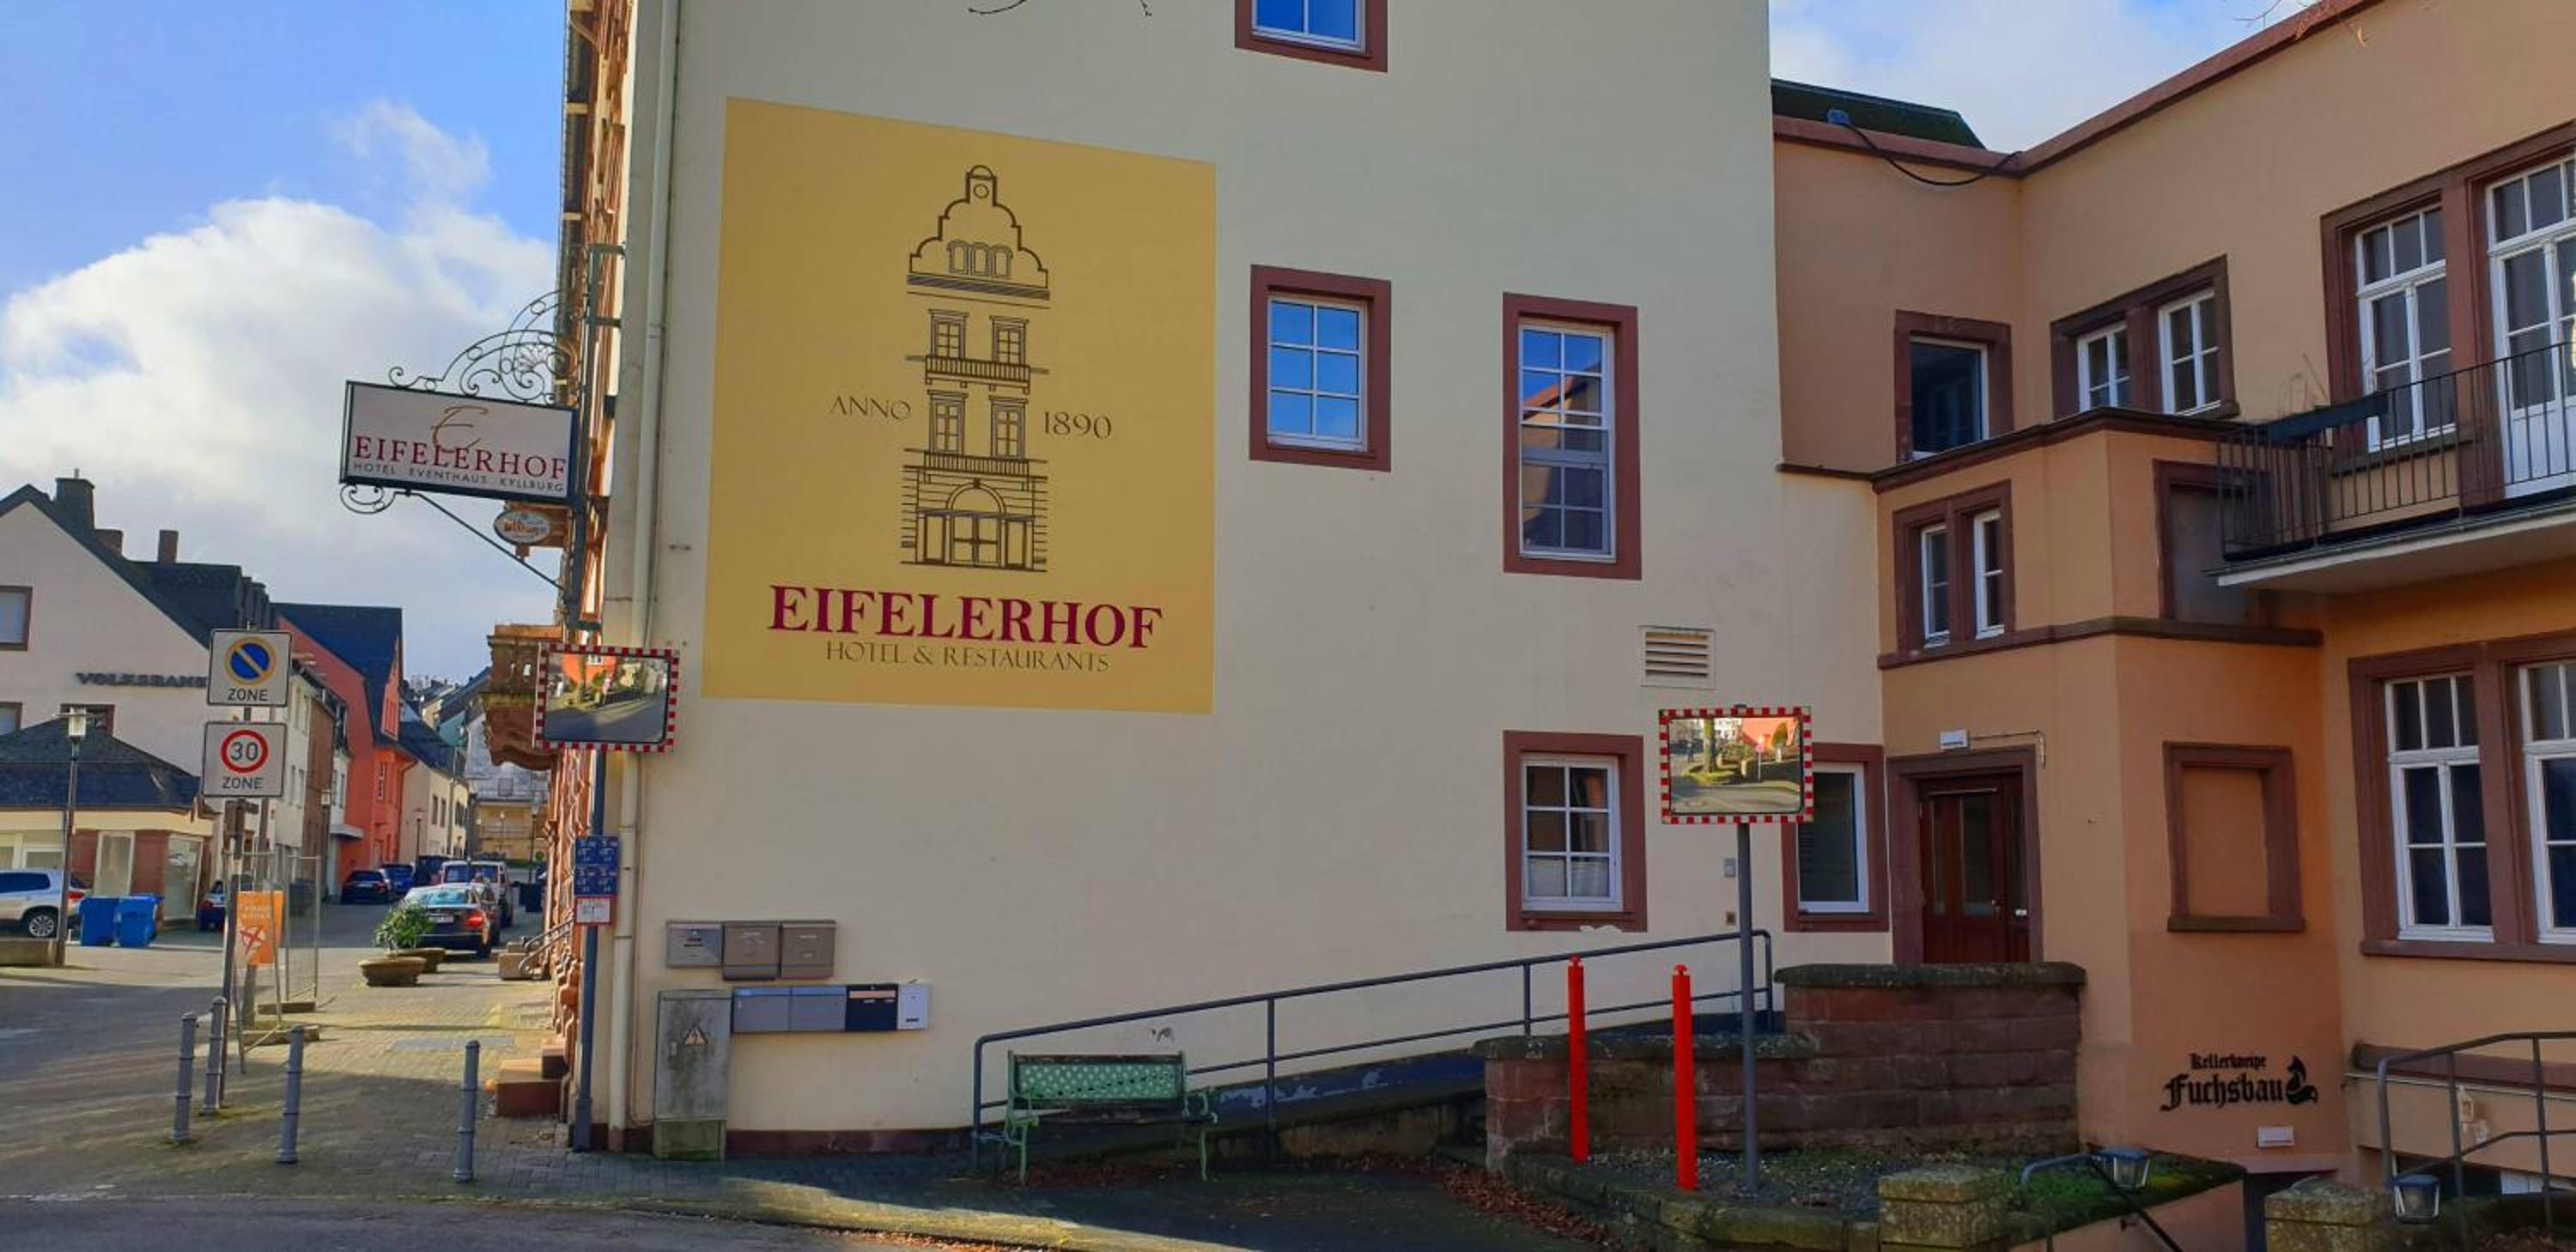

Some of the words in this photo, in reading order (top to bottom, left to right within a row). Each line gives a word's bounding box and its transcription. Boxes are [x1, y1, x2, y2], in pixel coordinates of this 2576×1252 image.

[829, 395, 911, 421] ANNO
[1044, 411, 1112, 439] 1890
[354, 435, 567, 480] EIFELERHOF
[354, 462, 395, 475] HOTEL
[409, 468, 487, 483] EVENTHAUS
[500, 477, 563, 492] KYLLBURG
[769, 585, 1163, 649] EIFELERHOF
[826, 640, 908, 665] HOTEL
[913, 645, 933, 666] &
[944, 647, 1110, 673] RESTAURANTS
[228, 688, 269, 702] ZONE
[230, 741, 258, 762] 30
[222, 776, 263, 790] ZONE
[2160, 1072, 2284, 1111] Fuchsbau
